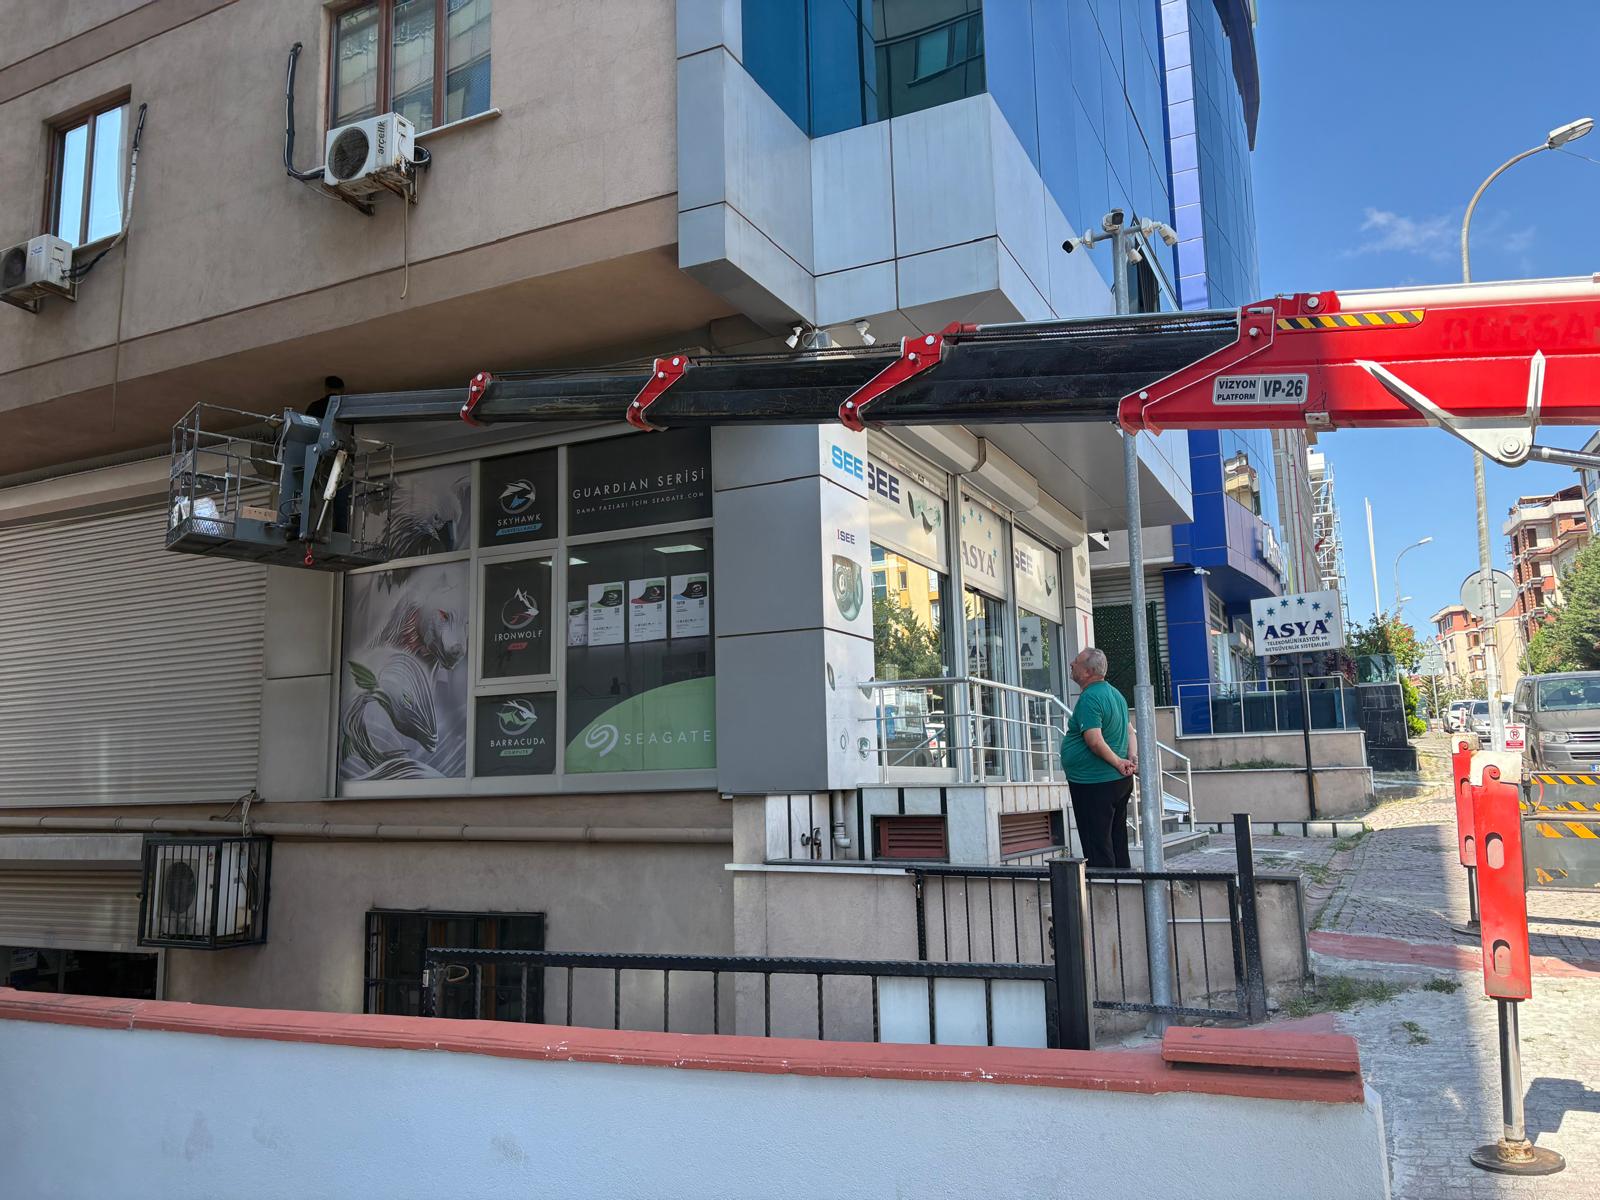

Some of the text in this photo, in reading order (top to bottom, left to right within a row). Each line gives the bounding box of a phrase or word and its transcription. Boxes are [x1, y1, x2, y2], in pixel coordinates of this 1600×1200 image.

[1264, 380, 1303, 397] VP-26
[832, 445, 864, 480] SEE
[573, 467, 704, 499] GUARDIAN SERİSİ
[867, 461, 900, 504] SEE
[497, 513, 541, 527] SKYHAWK
[837, 529, 855, 544] ISEE
[961, 541, 995, 577] ASYA
[1015, 548, 1033, 576] SEE
[494, 629, 543, 641] IRONWOLF
[1264, 619, 1331, 640] ASYA
[490, 737, 546, 748] BARRACUDA
[624, 730, 712, 745] SEAGATE
